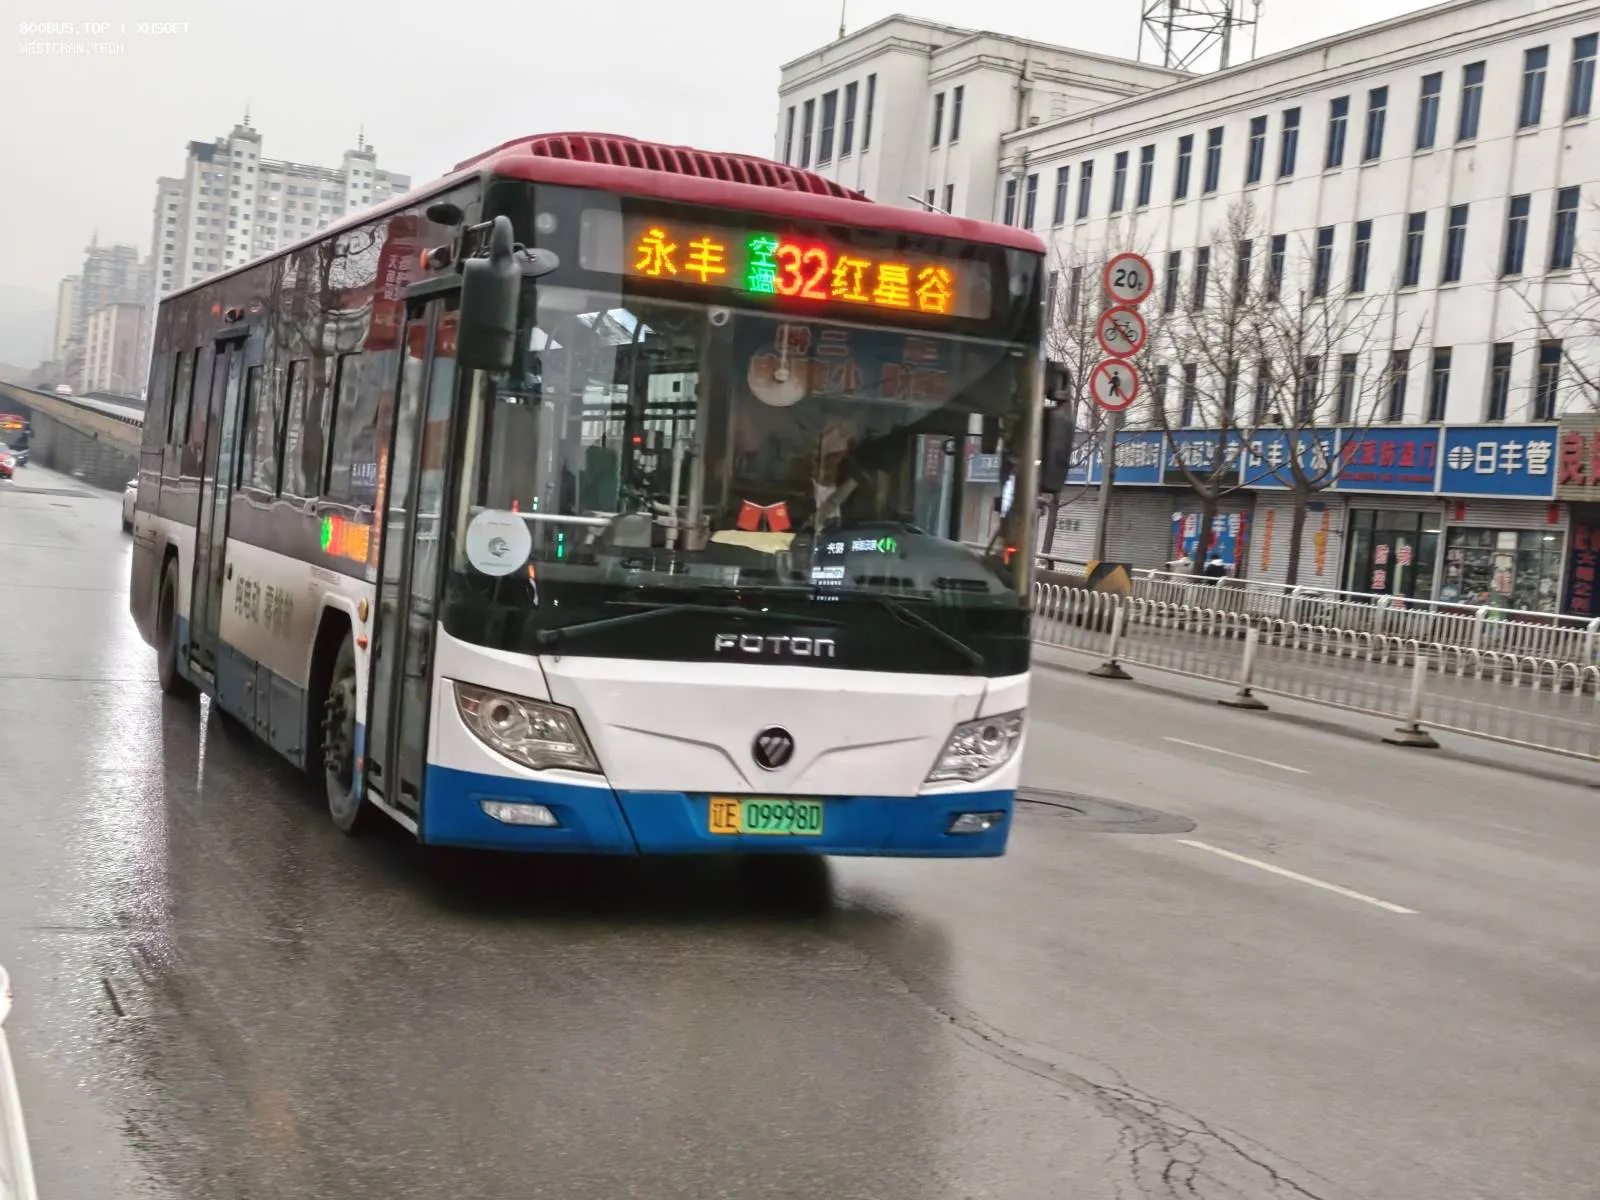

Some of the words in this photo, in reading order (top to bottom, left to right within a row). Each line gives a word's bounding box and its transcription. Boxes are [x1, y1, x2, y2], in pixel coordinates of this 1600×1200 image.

[636, 229, 727, 282] 永丰
[776, 244, 828, 300] 32
[832, 256, 953, 312] 红星谷
[1475, 440, 1552, 475] 日丰管
[714, 633, 836, 657] FOTON
[713, 801, 738, 829] 辽E
